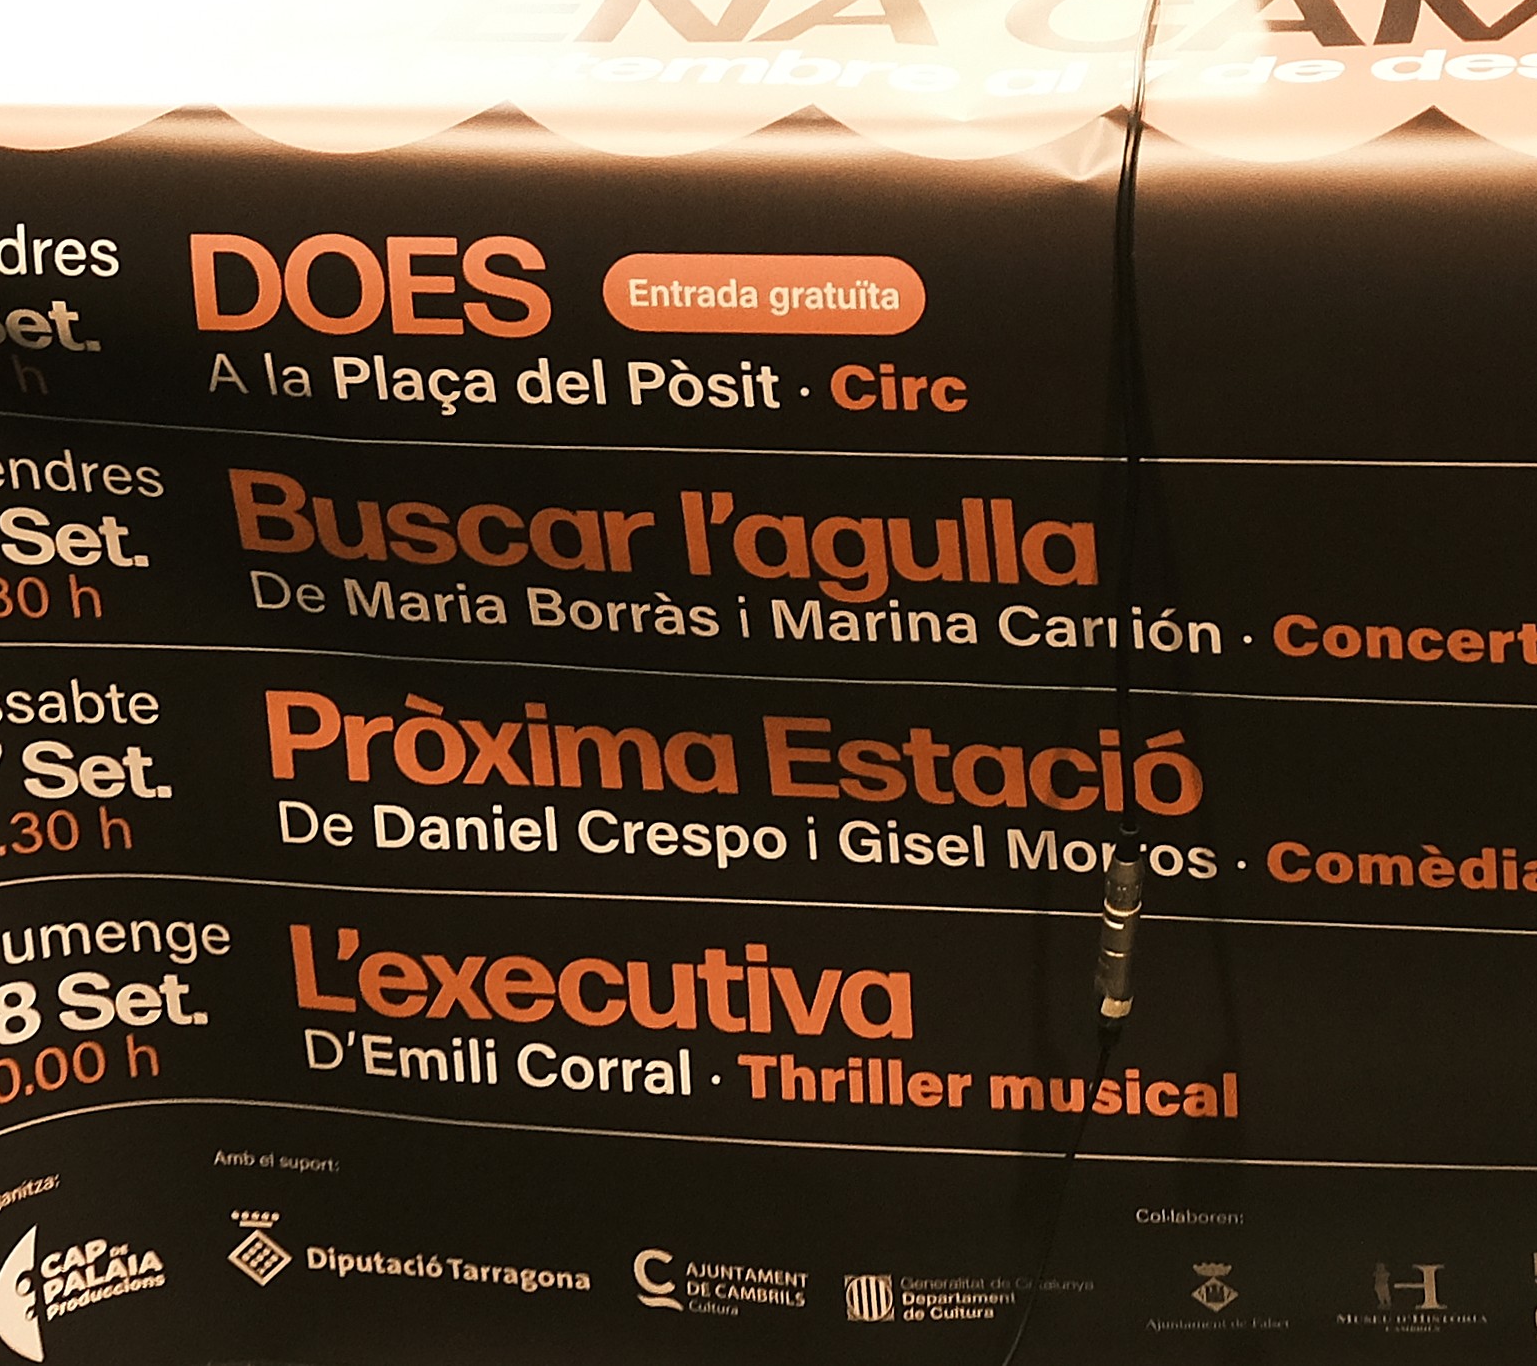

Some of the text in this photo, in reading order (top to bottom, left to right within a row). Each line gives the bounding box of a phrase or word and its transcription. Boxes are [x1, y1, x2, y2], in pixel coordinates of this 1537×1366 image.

[1218, 51, 1344, 85] de
[188, 232, 553, 340] DOES
[626, 276, 901, 319] Entrada gratuïta
[12, 349, 51, 397] h
[207, 351, 969, 417] A la Plaça del Pòsit Circ
[227, 467, 1101, 605] Buscar l'agulla
[69, 572, 104, 622] h
[249, 569, 328, 616] De
[343, 577, 508, 628] Maria
[526, 587, 721, 640] Borràs
[736, 594, 752, 640] i
[771, 598, 979, 646] Marina
[21, 738, 175, 802] Set.
[263, 688, 1206, 818] Pròxima Estació
[98, 804, 135, 853] h
[275, 799, 987, 870] De Daniel Crespo i Gisel
[55, 969, 211, 1036] Set.
[289, 922, 915, 1042] L'executiva
[124, 1032, 162, 1081] h
[303, 1027, 694, 1097] D'Emili Corral
[737, 1050, 1241, 1120] Thriller musical
[213, 1149, 342, 1174] Amb suport:
[39, 1237, 109, 1279] CAP
[305, 1245, 593, 1294] Diputació Tarragona
[684, 1260, 809, 1290] AJUNTAMENT
[46, 1272, 167, 1322] Produccions
[685, 1280, 808, 1310] DE CAMBRILS
[687, 1299, 741, 1318] Cultura
[901, 1290, 1017, 1308] Departament
[929, 1304, 996, 1322] Cultura
